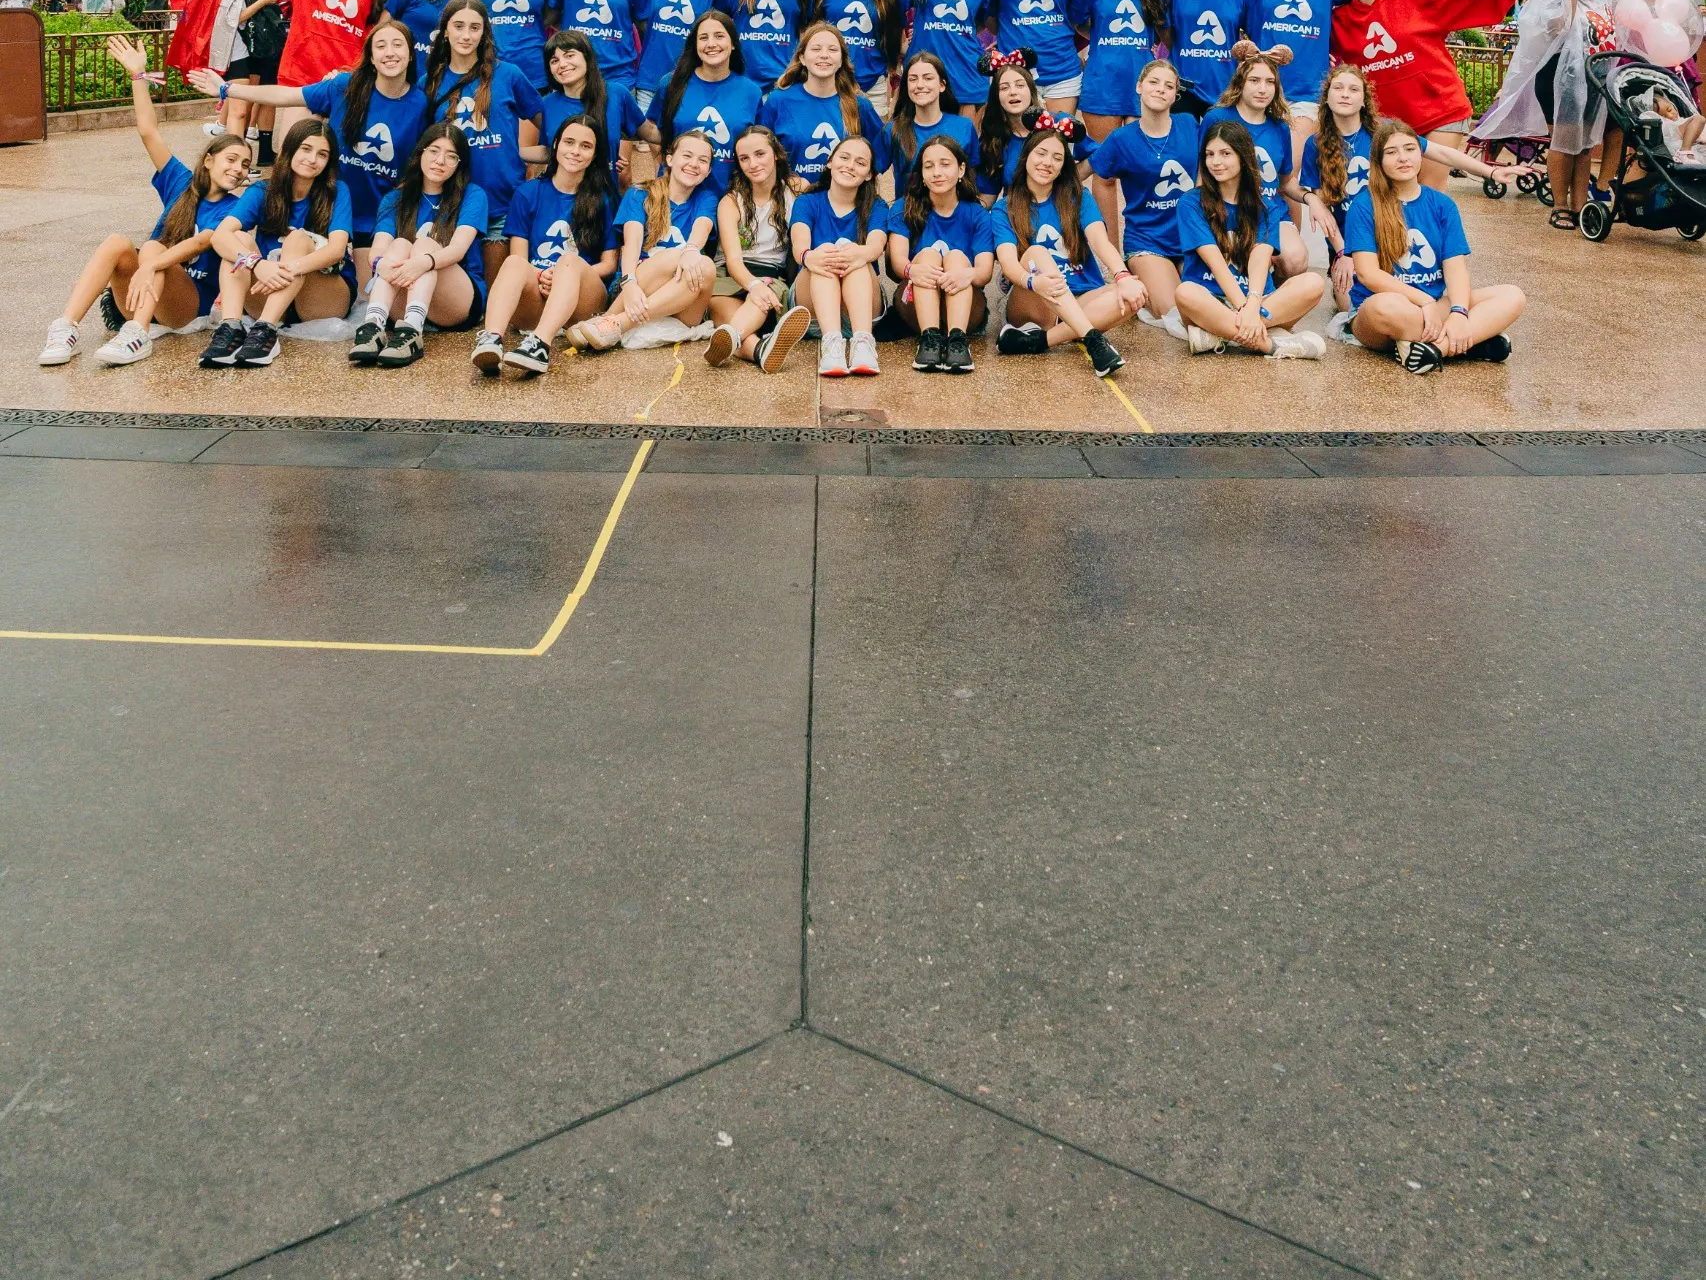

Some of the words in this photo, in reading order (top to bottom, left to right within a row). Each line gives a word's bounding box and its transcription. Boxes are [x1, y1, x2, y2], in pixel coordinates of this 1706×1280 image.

[1012, 15, 1056, 26] AMERICAN
[1057, 14, 1064, 22] 15
[923, 22, 967, 34] AMERICAN
[1262, 21, 1312, 35] AMERICAN
[1313, 26, 1320, 36] 15
[613, 29, 622, 39] 15
[739, 32, 785, 42] AMERICAN
[1098, 37, 1146, 46] AMERICAN
[1180, 48, 1227, 58] AMERICAN
[1361, 55, 1404, 74] AMERICAN
[1404, 51, 1414, 61] 15
[491, 133, 502, 144] 15
